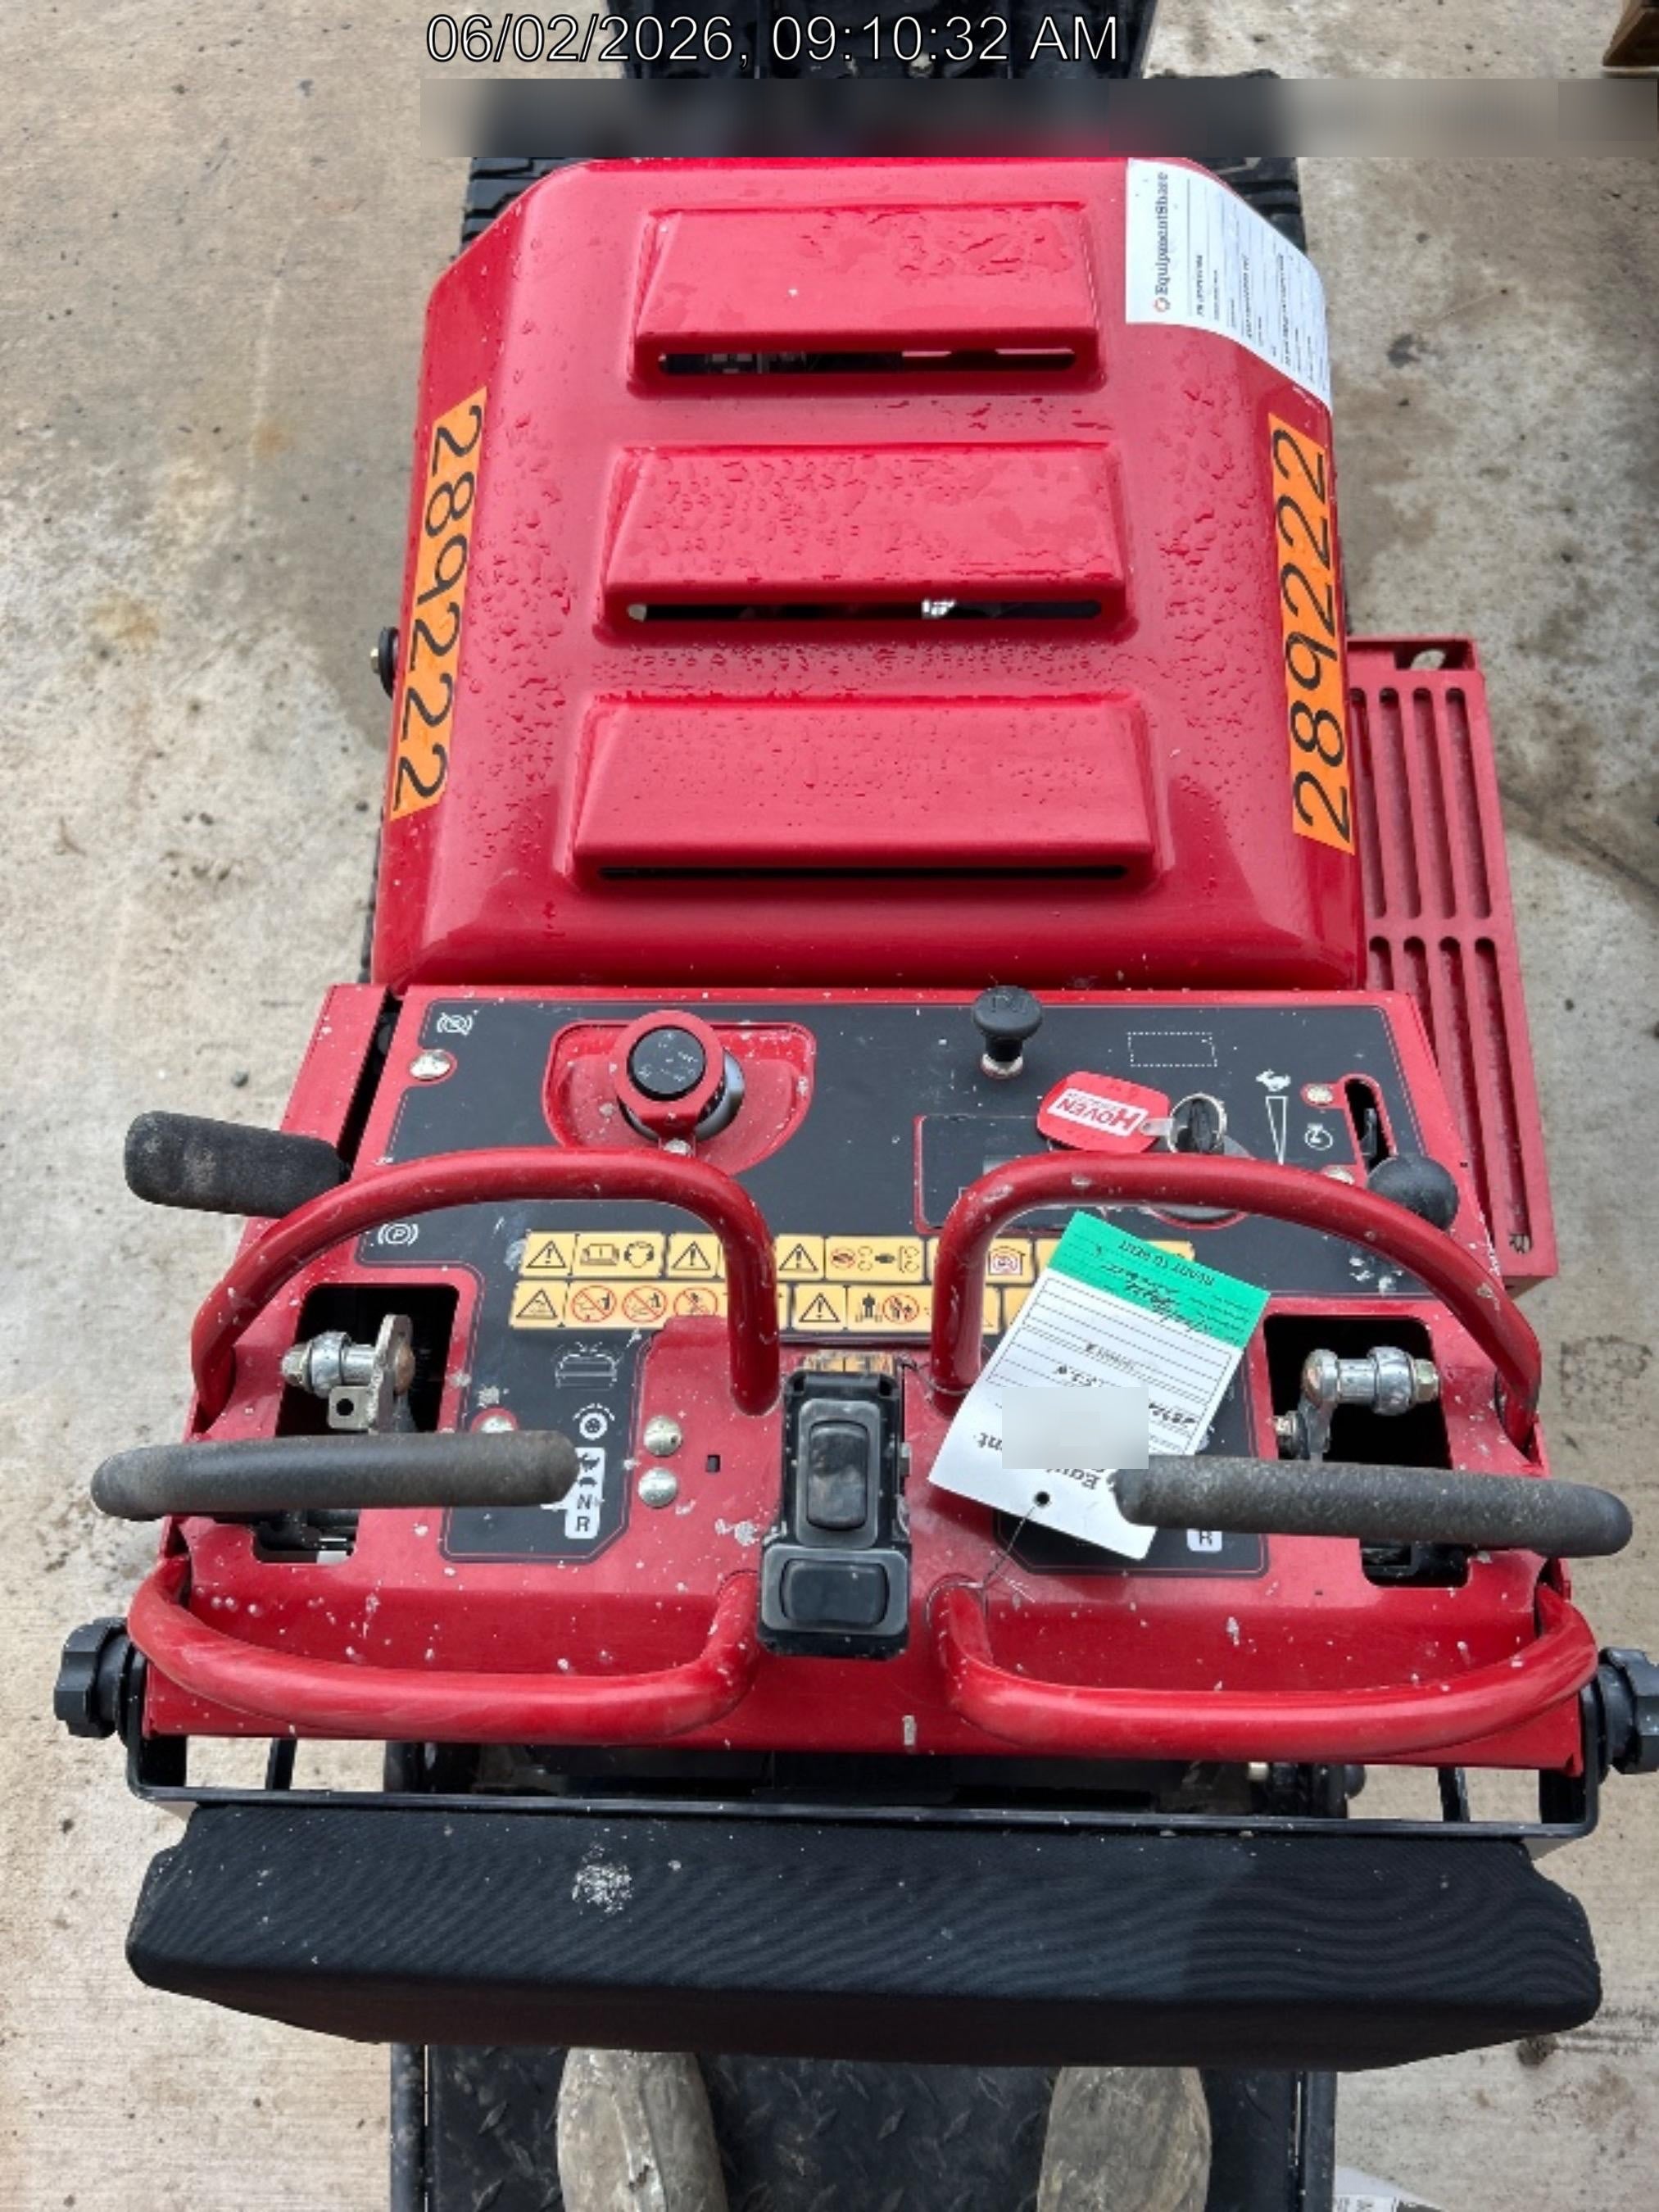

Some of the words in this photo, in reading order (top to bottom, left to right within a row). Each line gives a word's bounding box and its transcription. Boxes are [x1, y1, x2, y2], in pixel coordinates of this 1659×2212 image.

[1154, 171, 1171, 295] EquipmentShare
[392, 405, 483, 811] 289222
[1272, 428, 1351, 843] 289222
[1055, 1098, 1140, 1131] HOVEN
[575, 1516, 591, 1532] R
[576, 1494, 592, 1510] N
